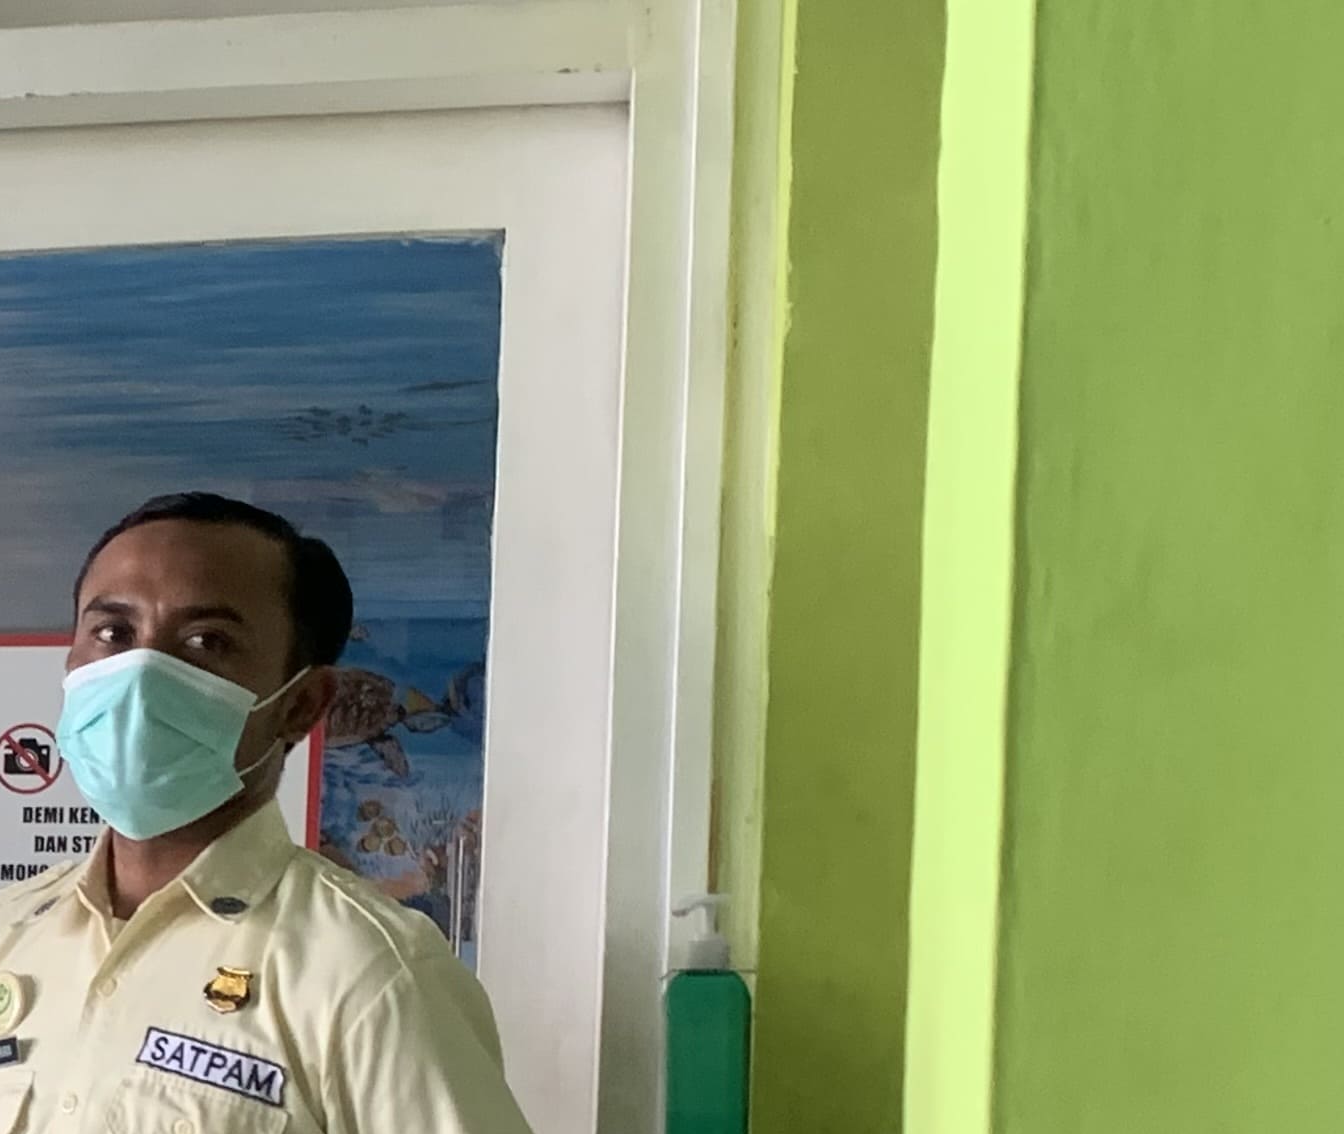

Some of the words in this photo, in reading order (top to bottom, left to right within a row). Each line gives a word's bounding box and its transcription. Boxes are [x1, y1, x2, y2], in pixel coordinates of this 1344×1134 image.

[22, 806, 65, 824] DEMI
[68, 806, 108, 824] KEN
[34, 835, 68, 853] DAN
[150, 1036, 278, 1097] SATPAM
